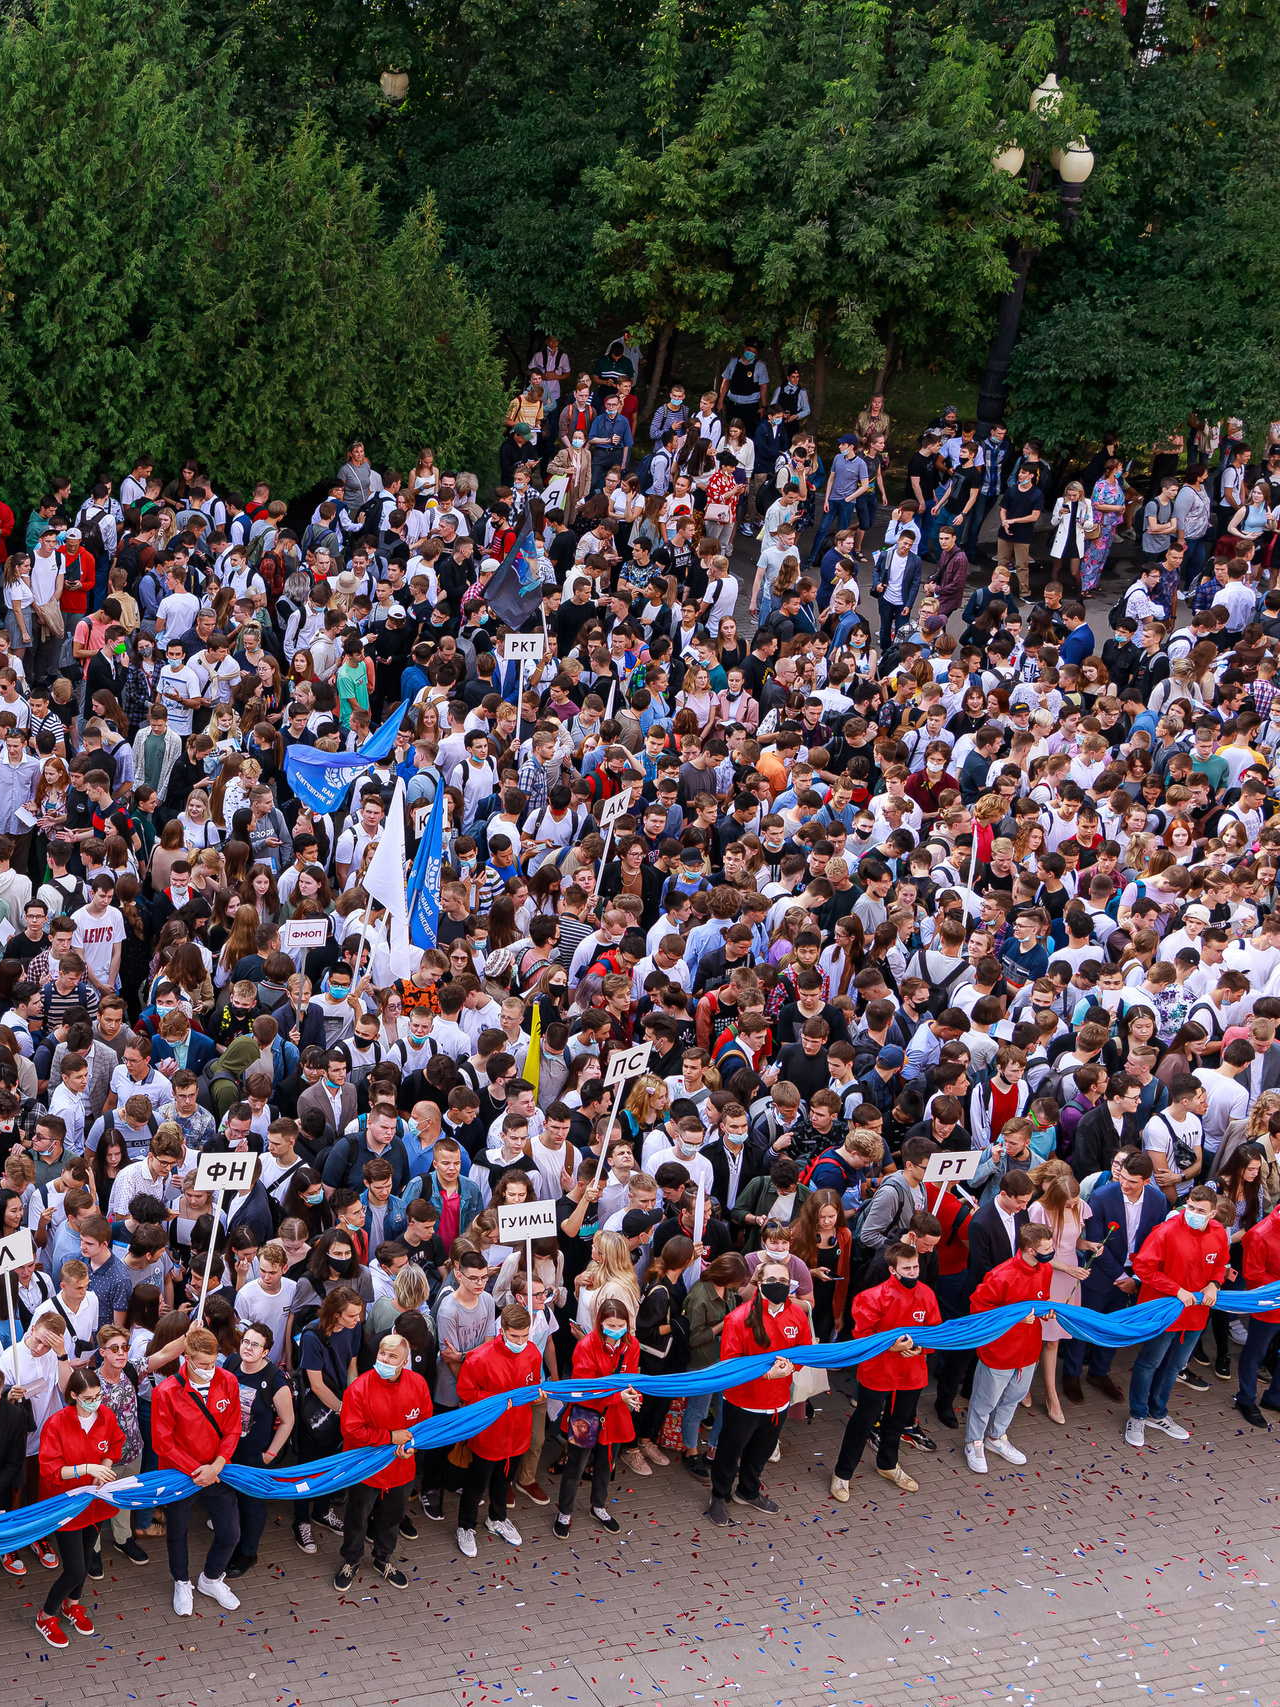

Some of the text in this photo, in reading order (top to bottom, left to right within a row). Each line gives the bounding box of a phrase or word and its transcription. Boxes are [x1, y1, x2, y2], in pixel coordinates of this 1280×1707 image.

[512, 641, 536, 652] РКТ
[606, 796, 626, 818] АК
[250, 828, 274, 838] CROPP
[83, 926, 113, 943] LEVI'S
[292, 930, 322, 938] ФМОП
[612, 1052, 644, 1077] ПС
[207, 1161, 247, 1181] ФН
[938, 1159, 967, 1175] РТ
[501, 1213, 554, 1228] ГУИМЦ
